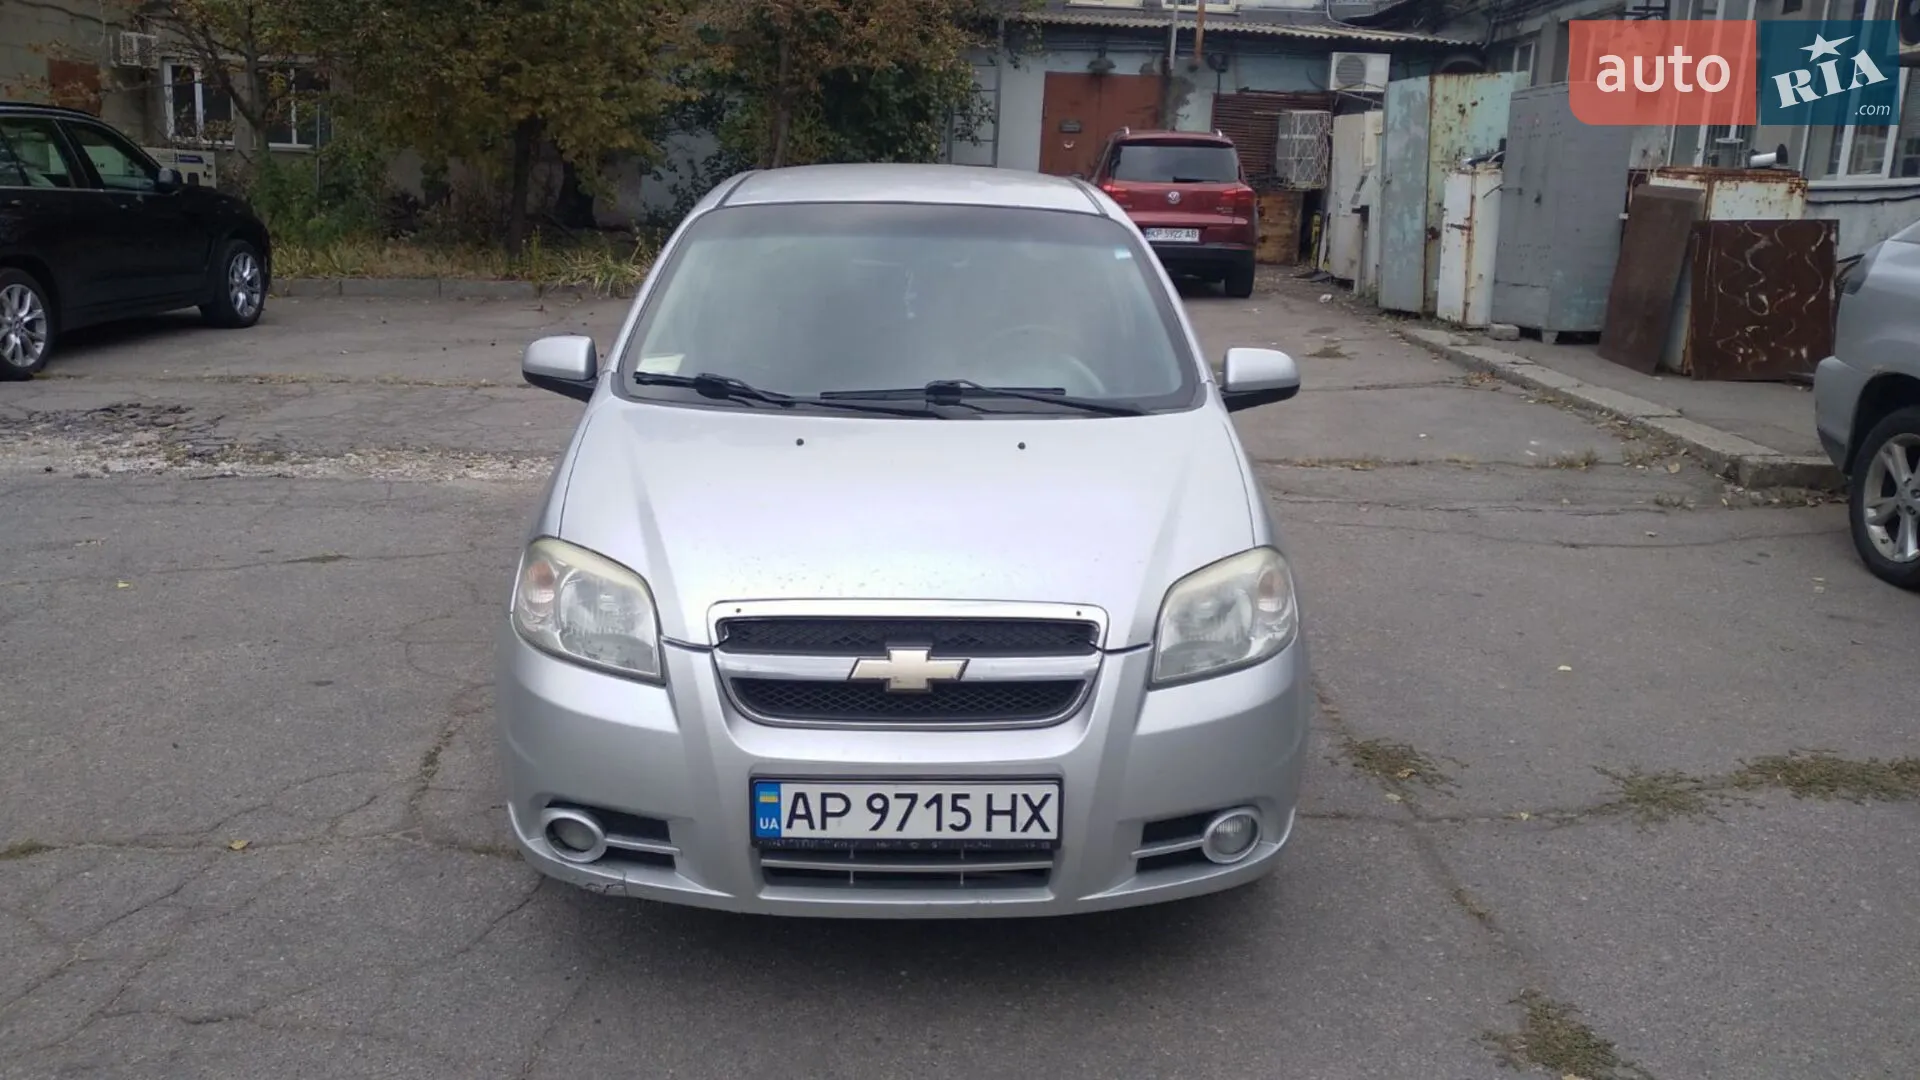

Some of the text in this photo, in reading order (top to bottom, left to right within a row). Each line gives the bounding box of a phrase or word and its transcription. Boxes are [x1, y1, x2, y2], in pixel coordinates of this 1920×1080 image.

[759, 792, 1052, 833] UA AP 9715 HX
